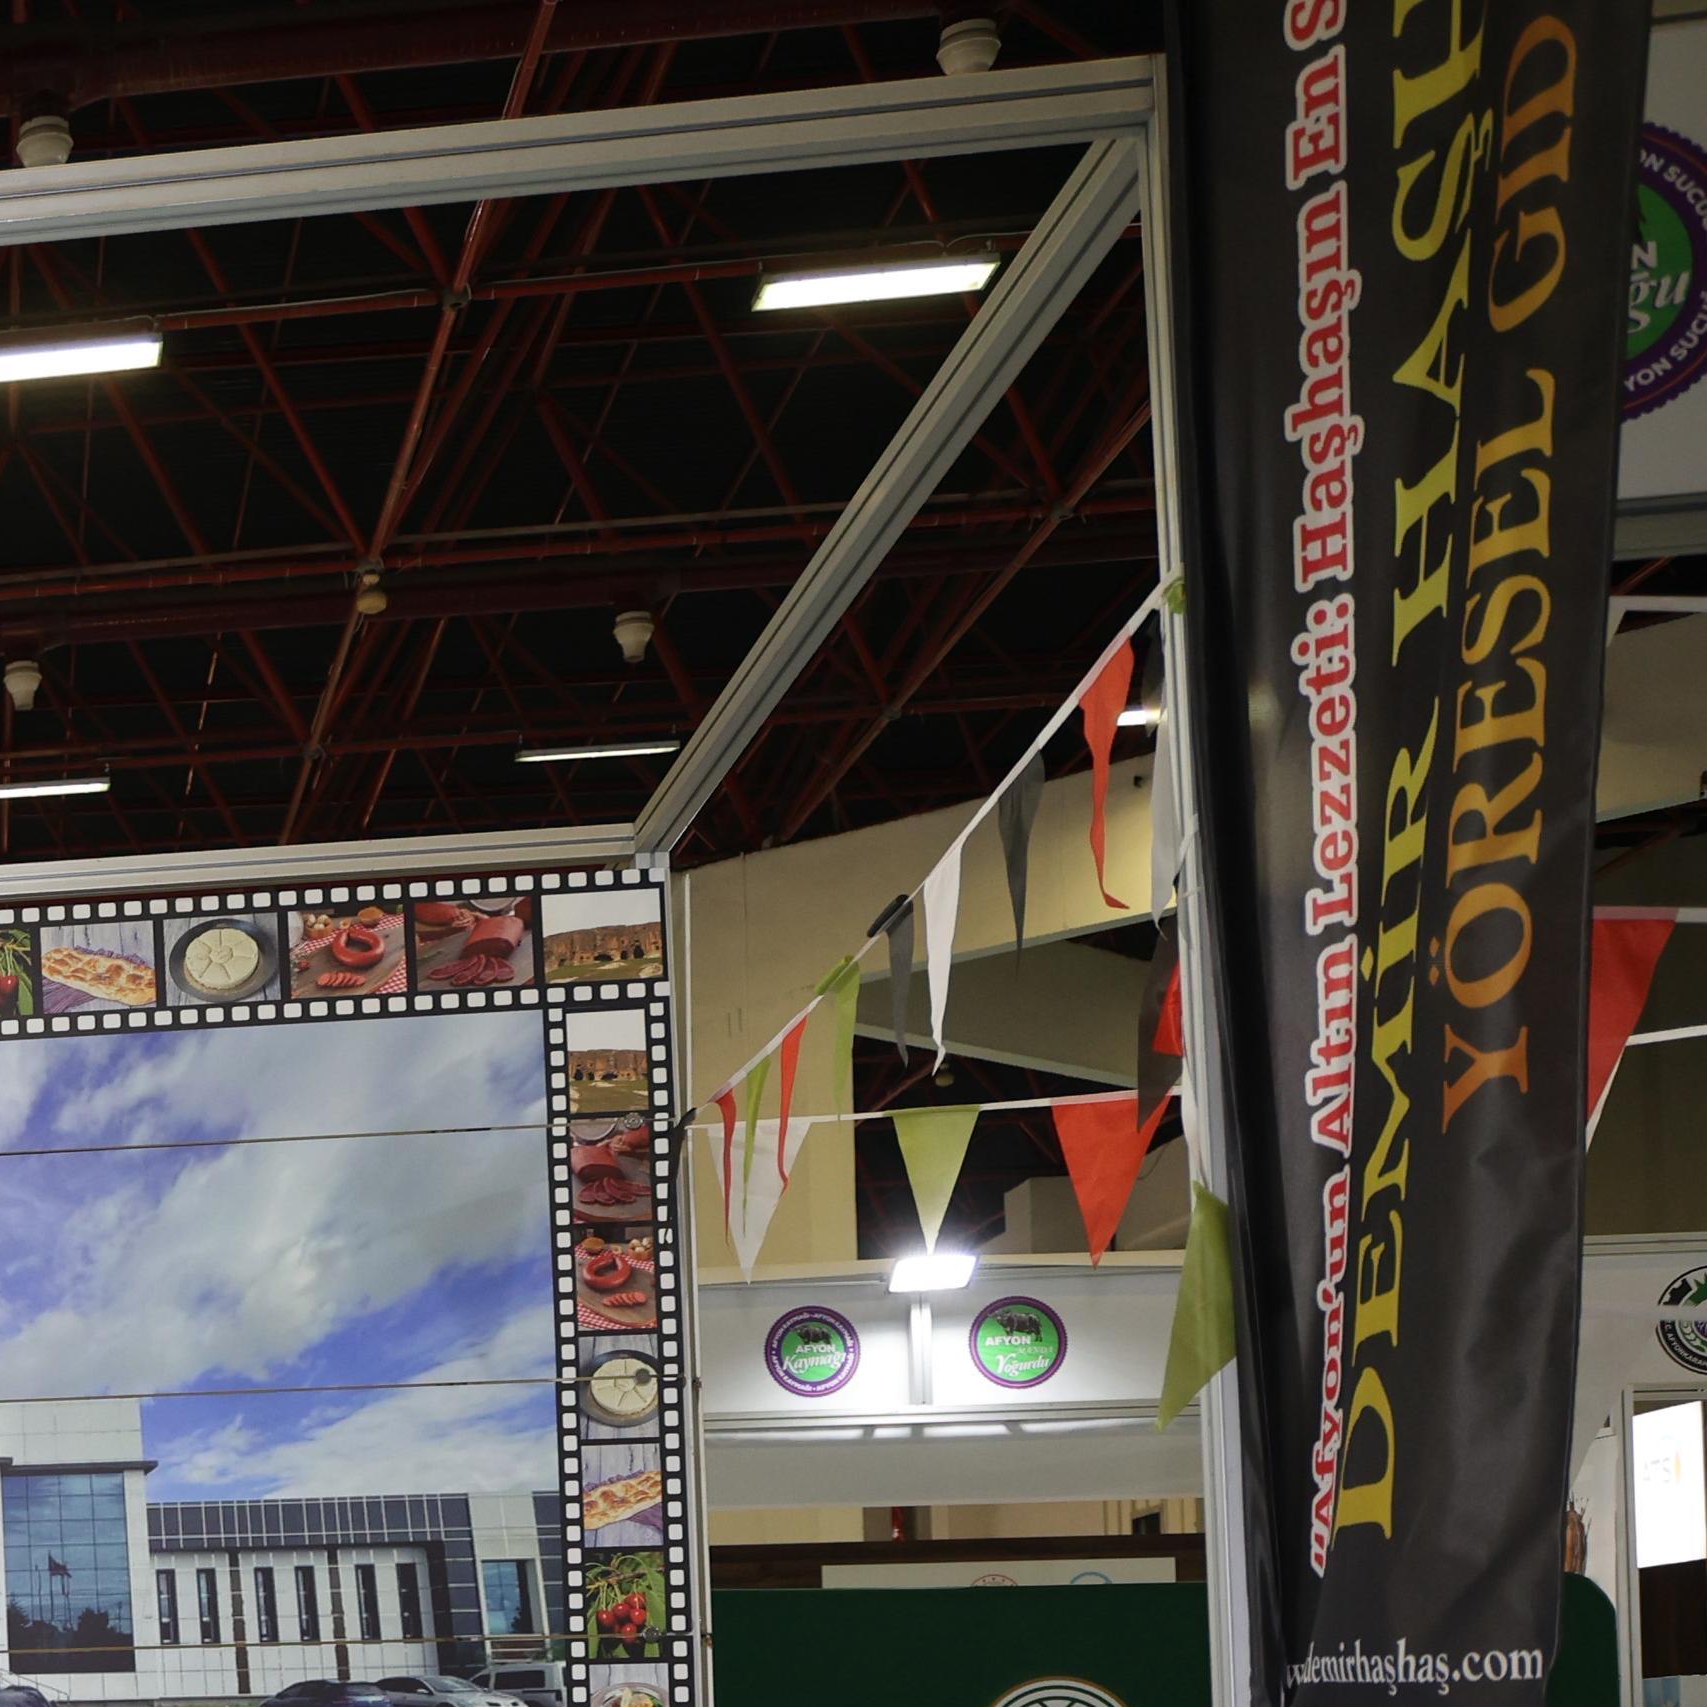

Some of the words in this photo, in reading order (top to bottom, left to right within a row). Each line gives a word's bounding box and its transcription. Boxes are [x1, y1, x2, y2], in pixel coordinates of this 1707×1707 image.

[1285, 46, 1347, 190] En
[1285, 183, 1364, 592] Haşhaşın
[1291, 594, 1359, 934] Lezzeti:
[1428, 369, 1555, 1133] YÖRESEL
[1305, 935, 1358, 1160] Altın
[1331, 696, 1439, 1545] DEMİR
[796, 1345, 835, 1353] AFYON
[985, 1335, 1031, 1346] AFYON
[996, 1353, 1050, 1377] Yoğurdu
